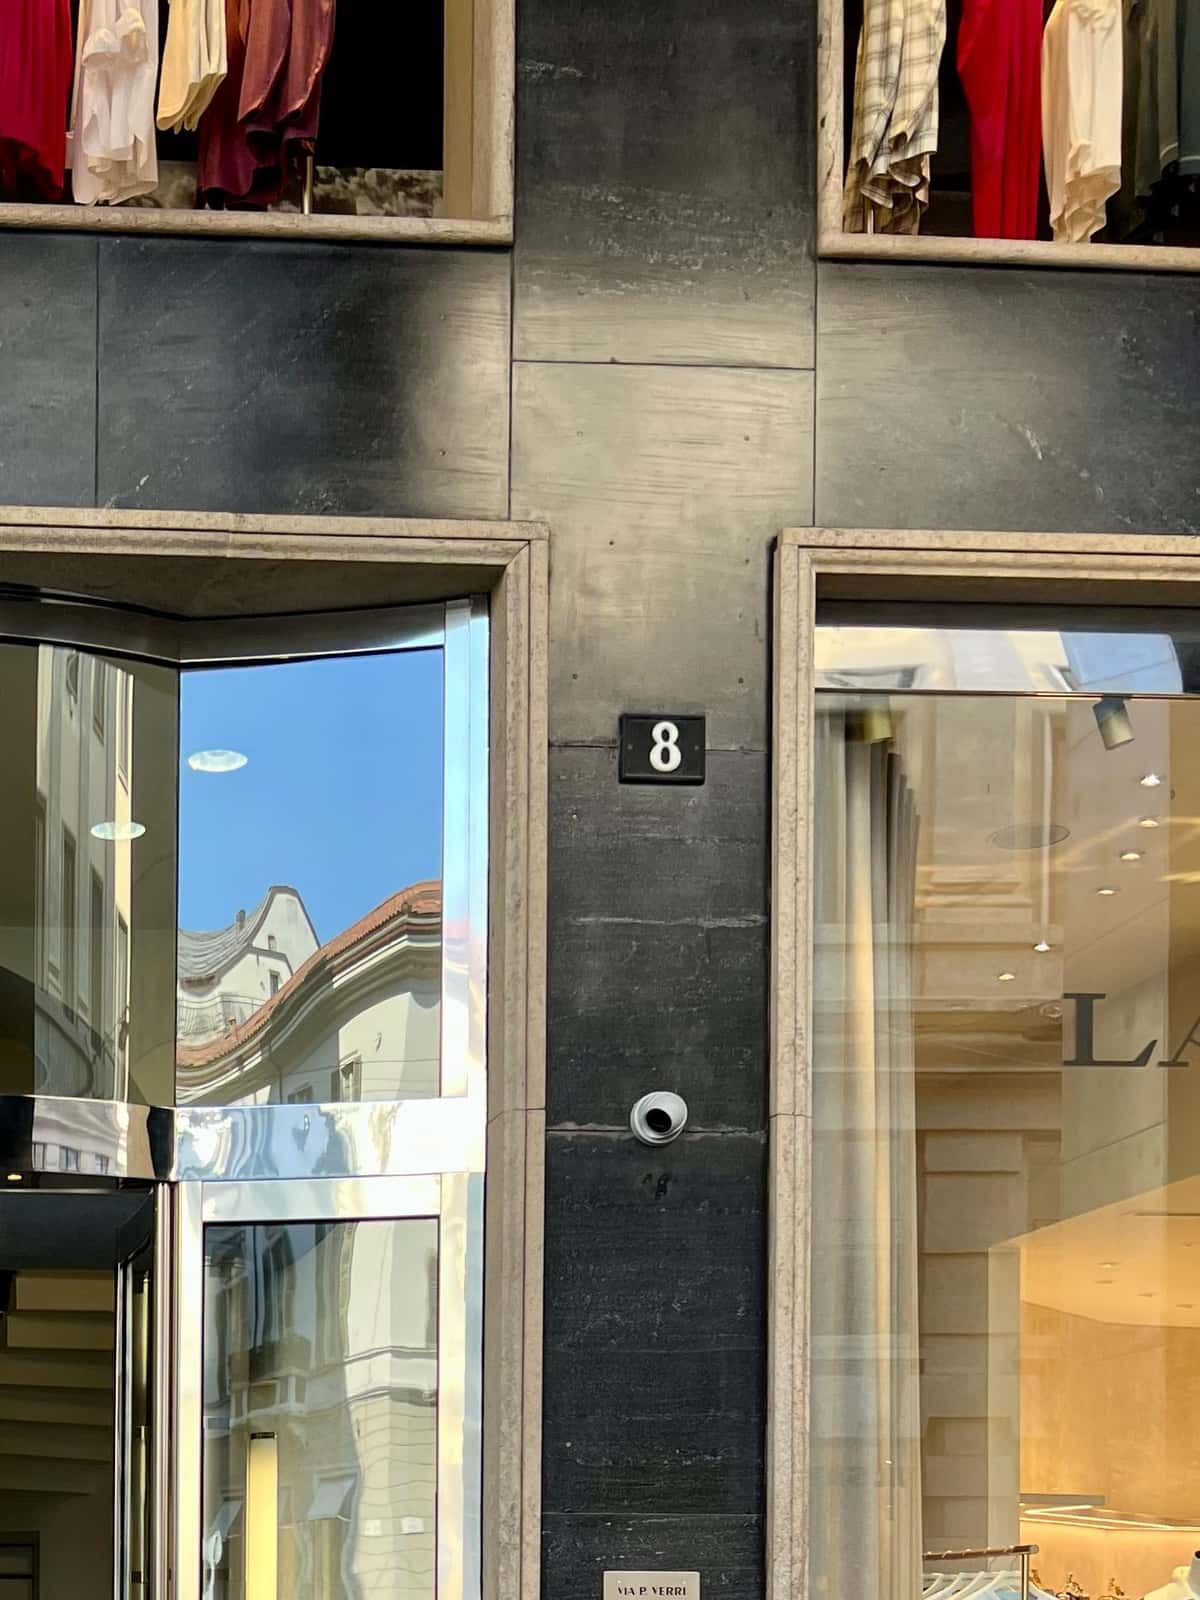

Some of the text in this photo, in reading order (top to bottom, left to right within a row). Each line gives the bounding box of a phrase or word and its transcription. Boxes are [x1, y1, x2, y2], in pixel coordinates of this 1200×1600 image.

[649, 721, 681, 772] 8
[617, 1586, 635, 1596] VIA
[652, 1586, 687, 1596] VERRI
